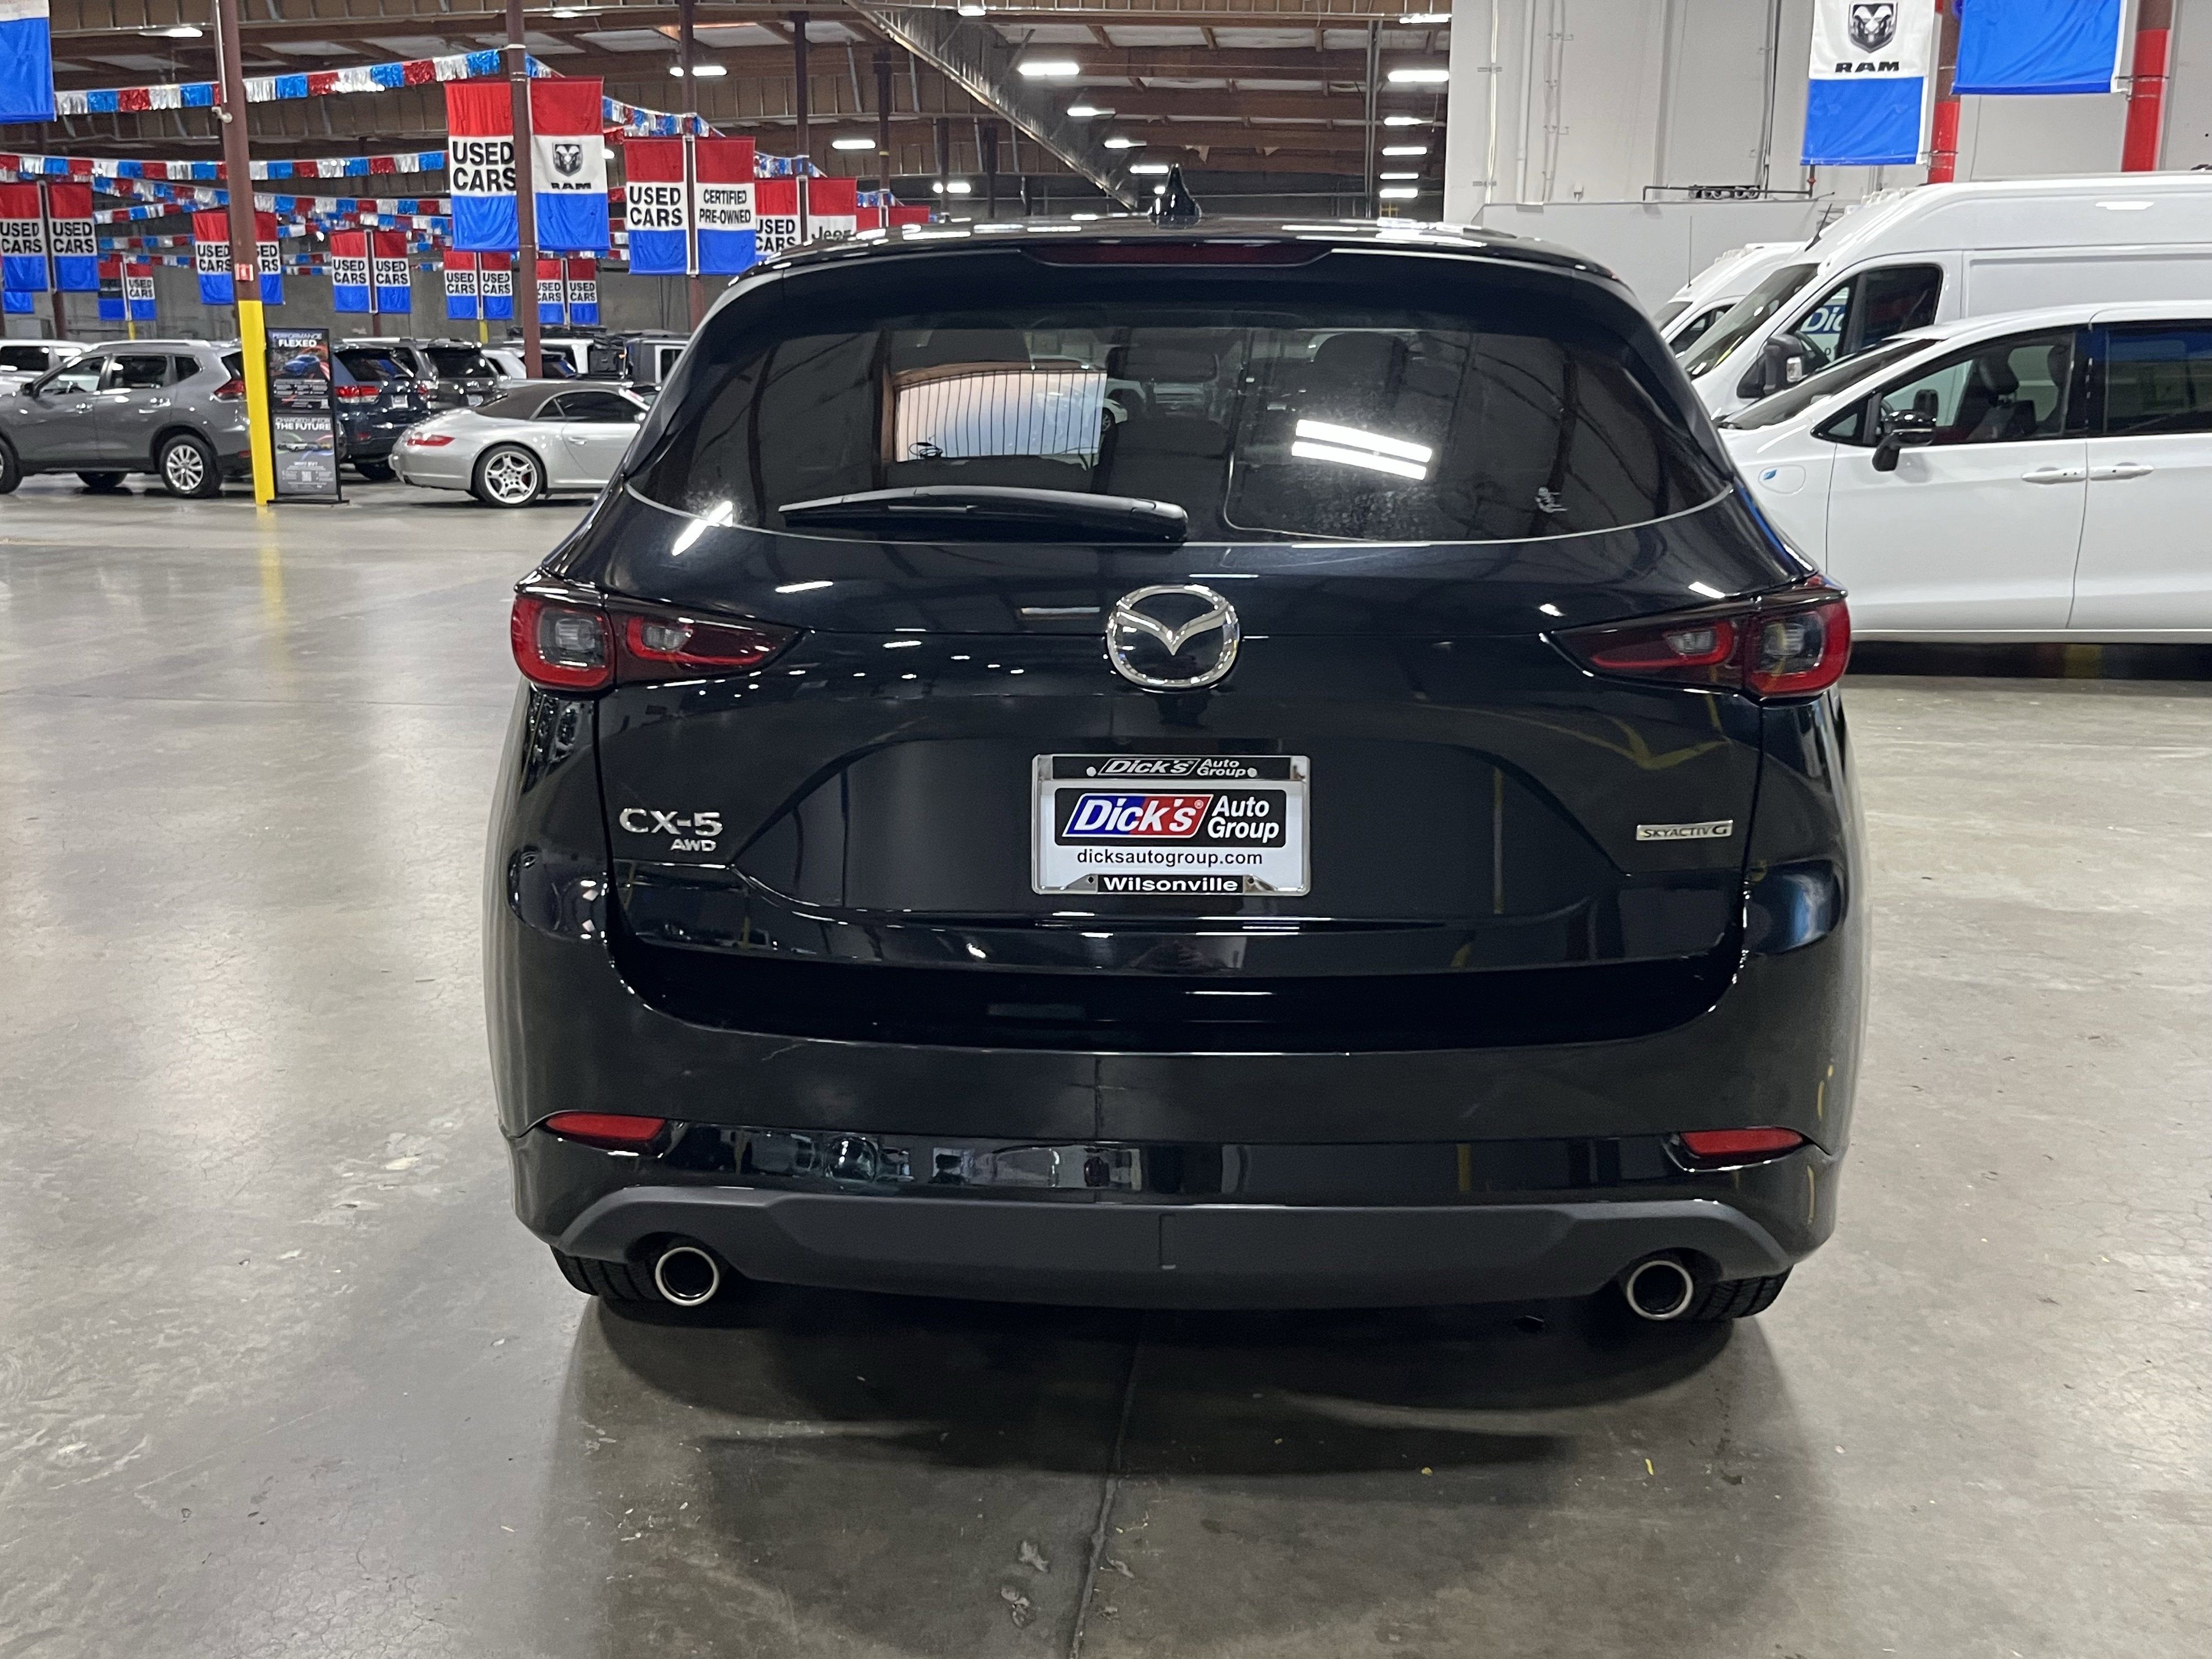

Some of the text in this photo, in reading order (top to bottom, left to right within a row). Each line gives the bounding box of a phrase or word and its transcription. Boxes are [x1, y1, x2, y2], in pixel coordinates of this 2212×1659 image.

[1835, 61, 1899, 73] RAM
[453, 141, 515, 166] USED
[453, 167, 516, 192] CARS
[629, 186, 681, 206] USED
[703, 189, 747, 205] CERTIFIED
[630, 207, 682, 227] CARS
[699, 208, 751, 224] PRE-OWNED
[1, 222, 40, 237] USED
[53, 222, 93, 236] USED
[2, 239, 42, 253] CARS
[53, 239, 94, 253] CARS
[198, 244, 230, 257] USED
[199, 258, 231, 272] CARS
[334, 259, 365, 271] USED
[376, 261, 407, 272] USED
[128, 279, 152, 289] USED
[334, 272, 366, 284] CARS
[376, 273, 408, 285] CARS
[447, 273, 475, 283] USED
[483, 273, 510, 283] USED
[447, 284, 475, 294] CARS
[483, 284, 511, 295] CARS
[570, 282, 595, 291] USED
[129, 289, 153, 298] CARS
[570, 292, 595, 302] CARS
[278, 339, 317, 347] FLEXED
[295, 422, 331, 431] FUTURE
[1105, 759, 1240, 774] Dick's Auto
[1197, 767, 1246, 778] Group
[1074, 795, 1269, 832] Dick's Auto
[619, 808, 723, 837] CX-5
[1207, 817, 1279, 843] Group
[670, 838, 716, 851] AWD
[1077, 849, 1262, 867] dicksautogroup.com
[1103, 877, 1238, 891] Wilsonville
